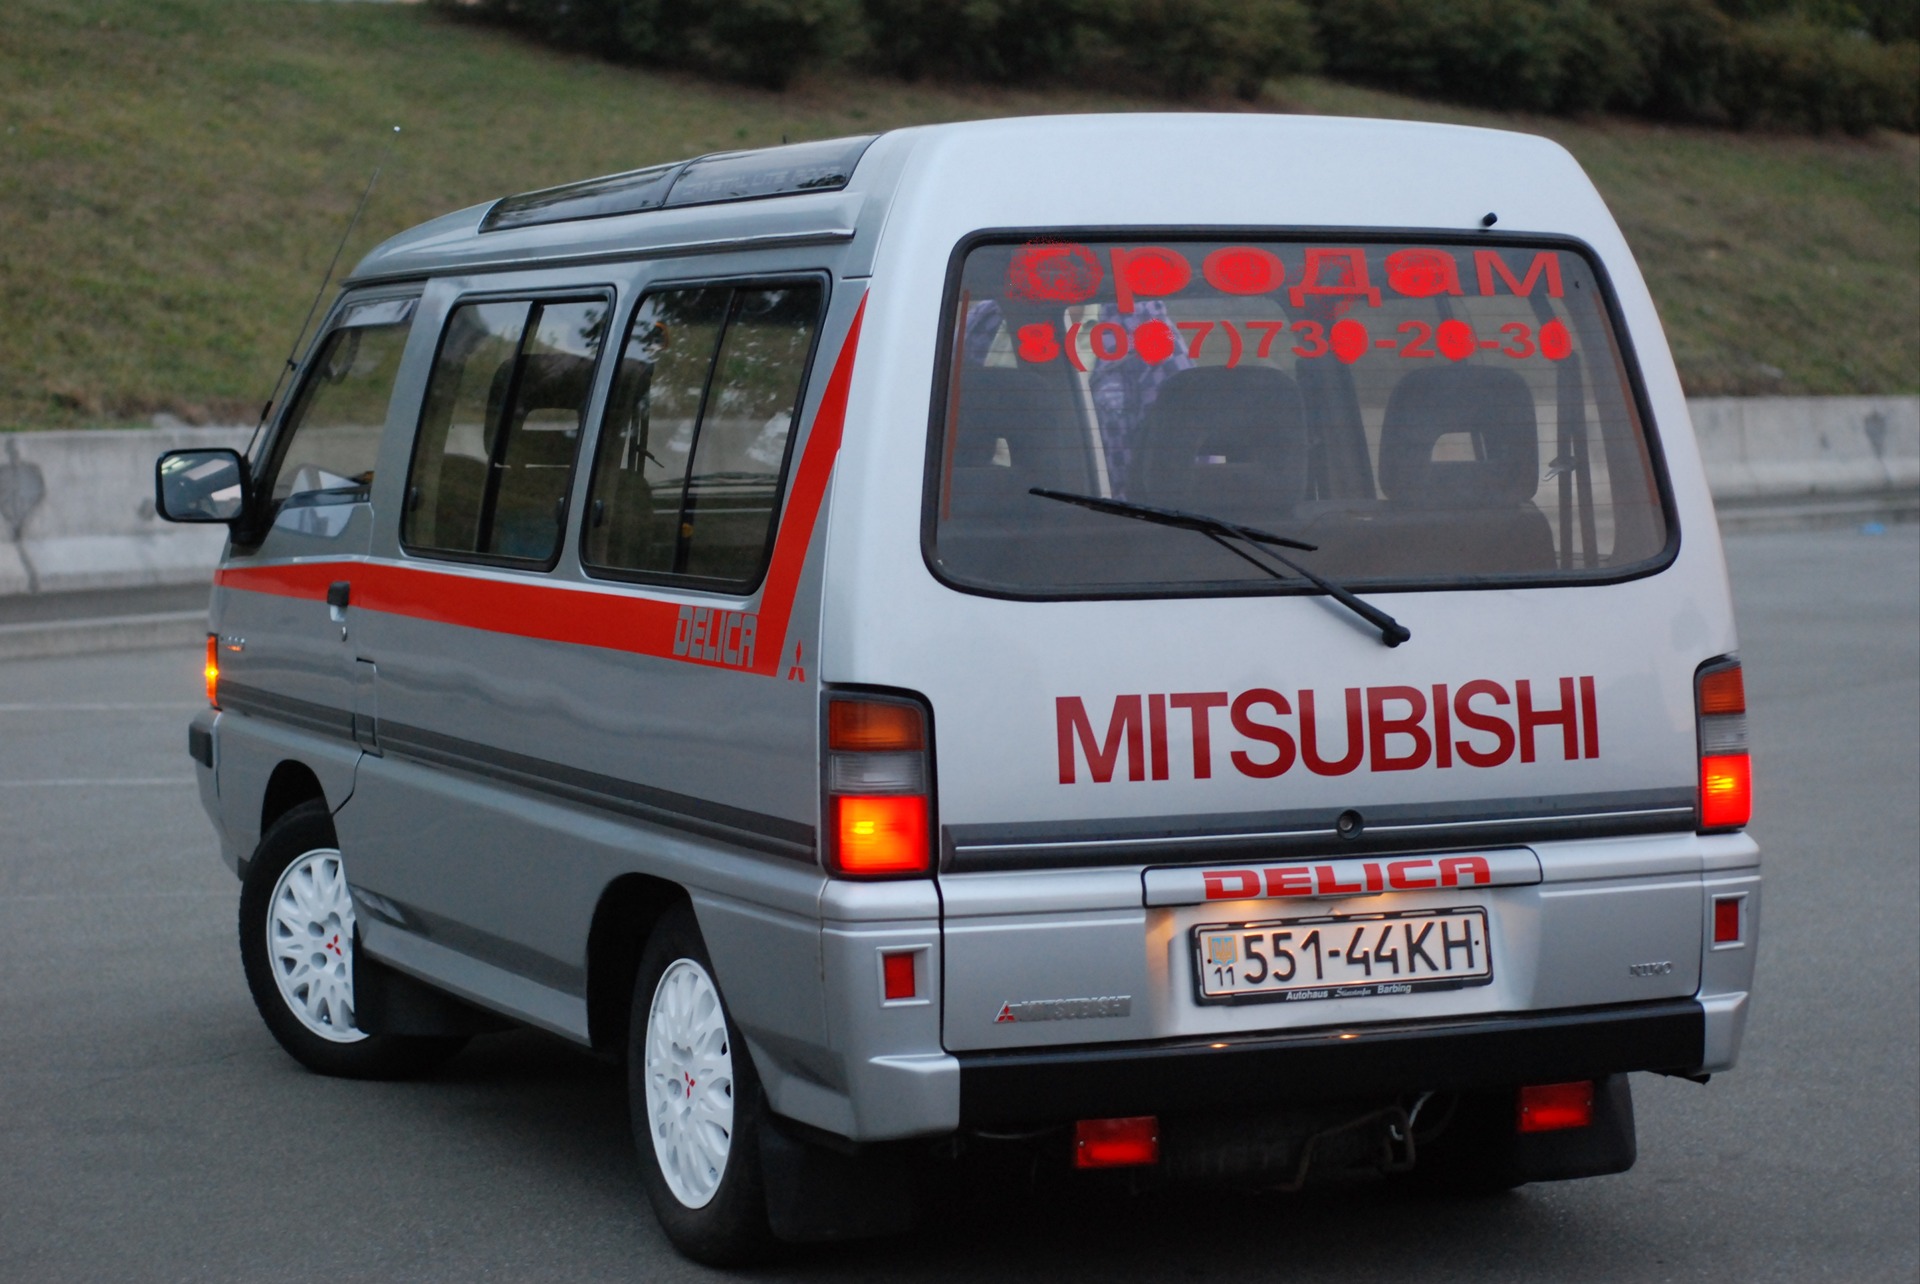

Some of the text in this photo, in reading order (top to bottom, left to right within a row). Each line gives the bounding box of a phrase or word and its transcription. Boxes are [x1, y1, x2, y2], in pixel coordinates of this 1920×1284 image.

[1007, 243, 1565, 314] родам
[1017, 318, 1572, 372] 8(07)73-2-3
[672, 604, 758, 668] DELICA
[1056, 676, 1600, 785] MITSUBISHI
[1202, 856, 1491, 900] DELICA
[1214, 965, 1236, 987] 11
[1286, 989, 1329, 1000] Autohaus
[1377, 983, 1412, 995] Barbing
